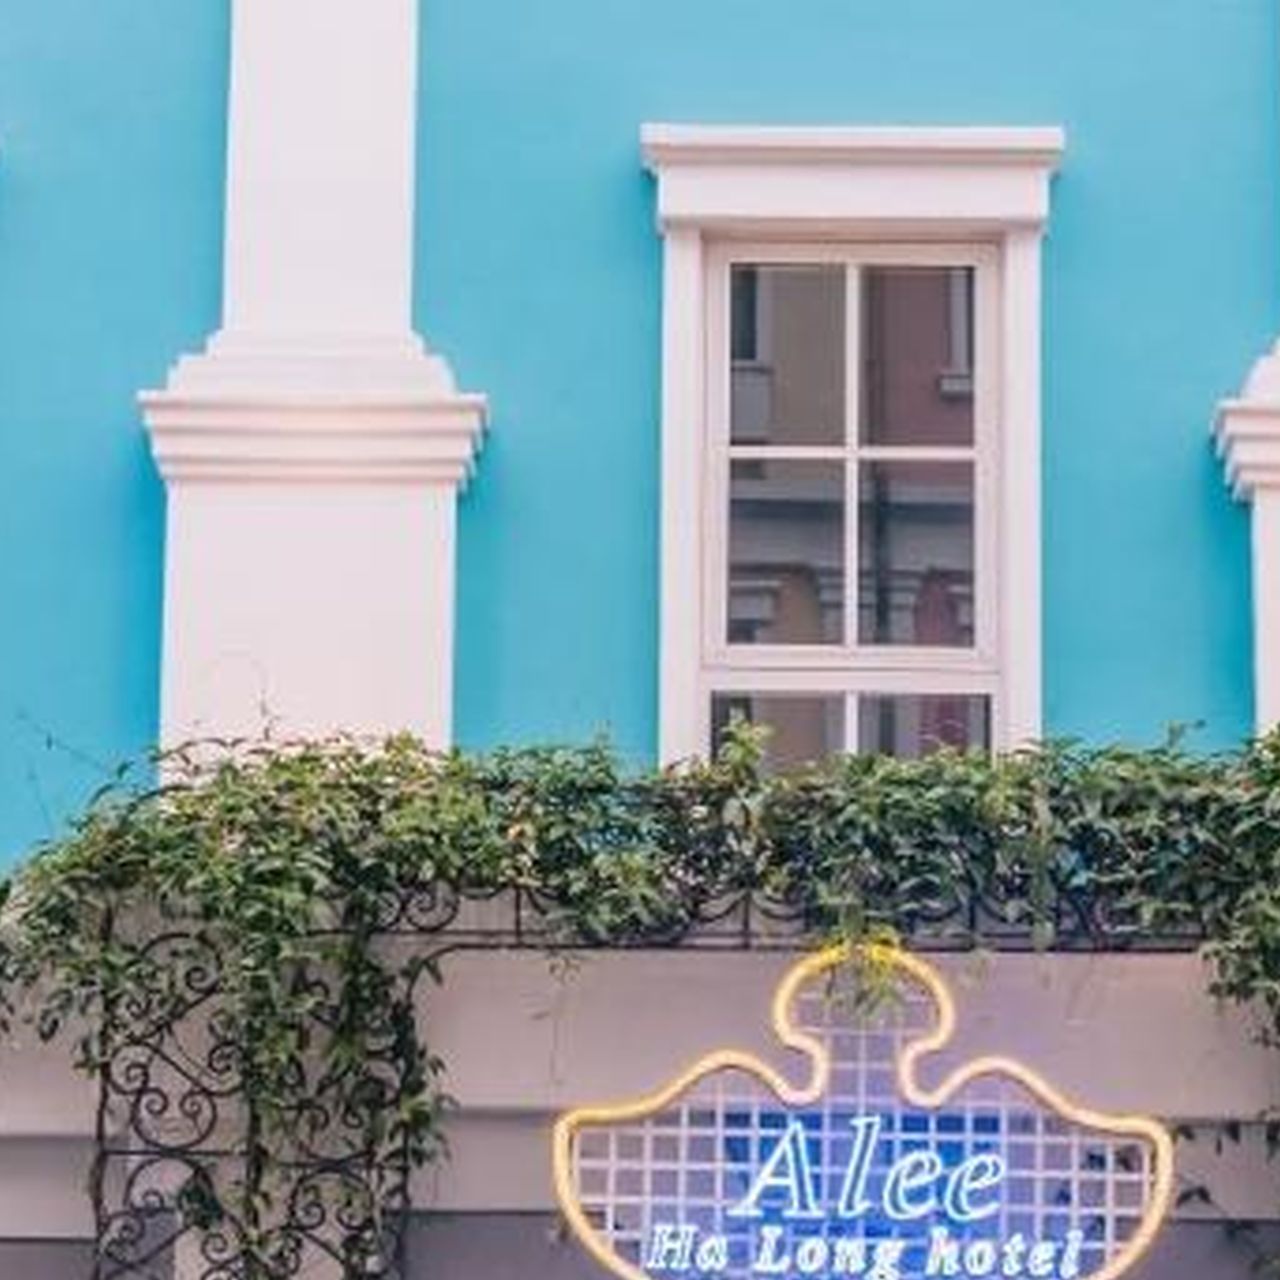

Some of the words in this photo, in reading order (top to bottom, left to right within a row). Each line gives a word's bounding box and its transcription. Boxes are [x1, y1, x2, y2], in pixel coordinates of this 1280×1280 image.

[727, 1115, 1007, 1222] Alee
[645, 1223, 729, 1271] Ha
[925, 1228, 1084, 1279] hotel
